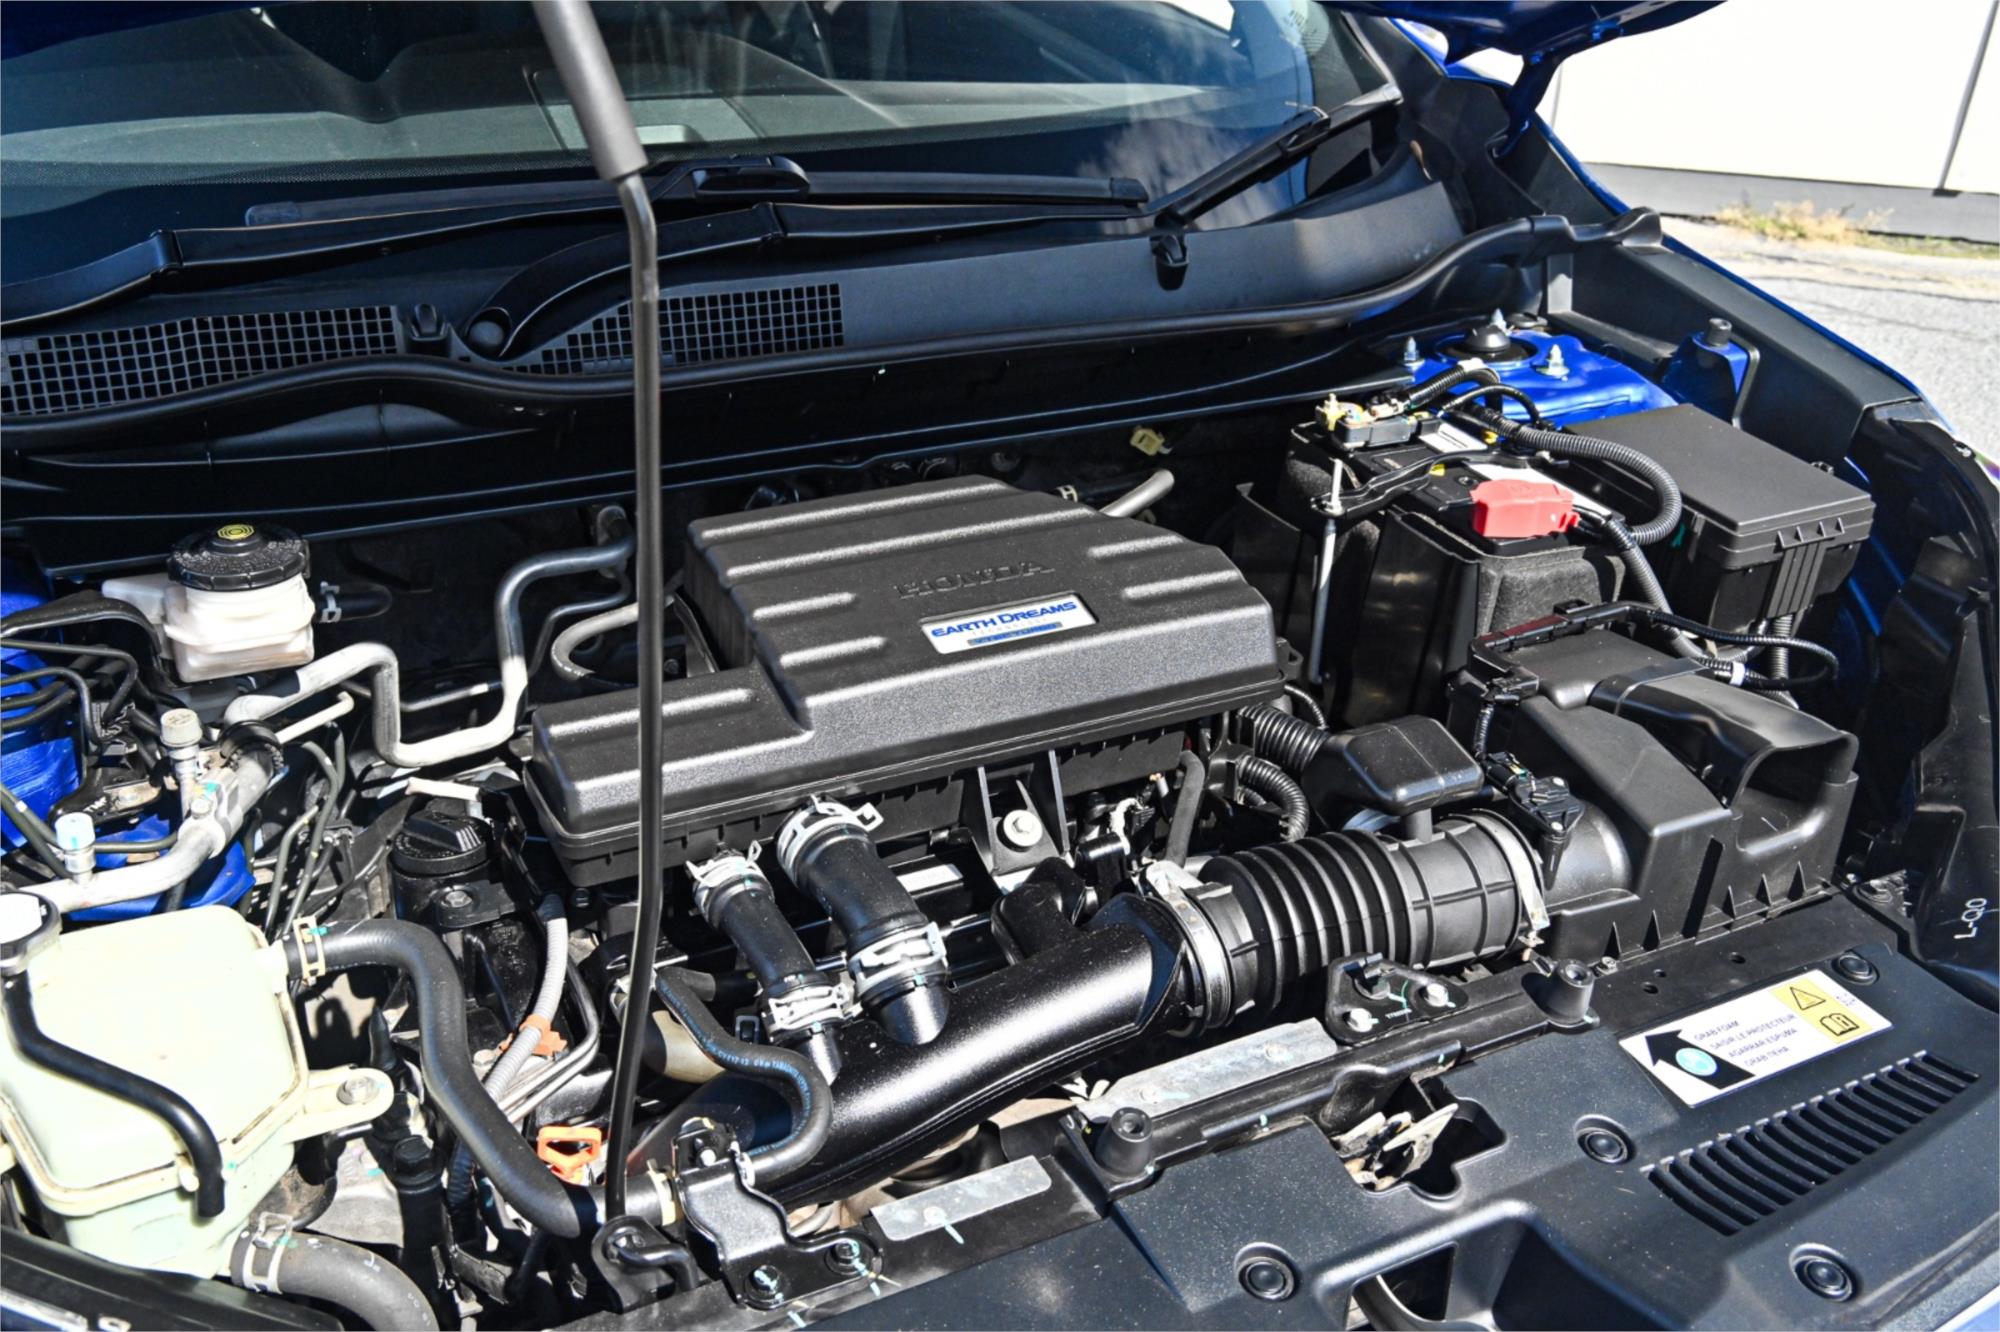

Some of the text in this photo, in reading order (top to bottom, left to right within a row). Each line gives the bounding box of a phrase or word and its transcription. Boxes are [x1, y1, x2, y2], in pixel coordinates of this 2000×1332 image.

[893, 561, 1056, 600] HONDA
[931, 618, 997, 638] EARTH
[997, 601, 1079, 625] DREAMS
